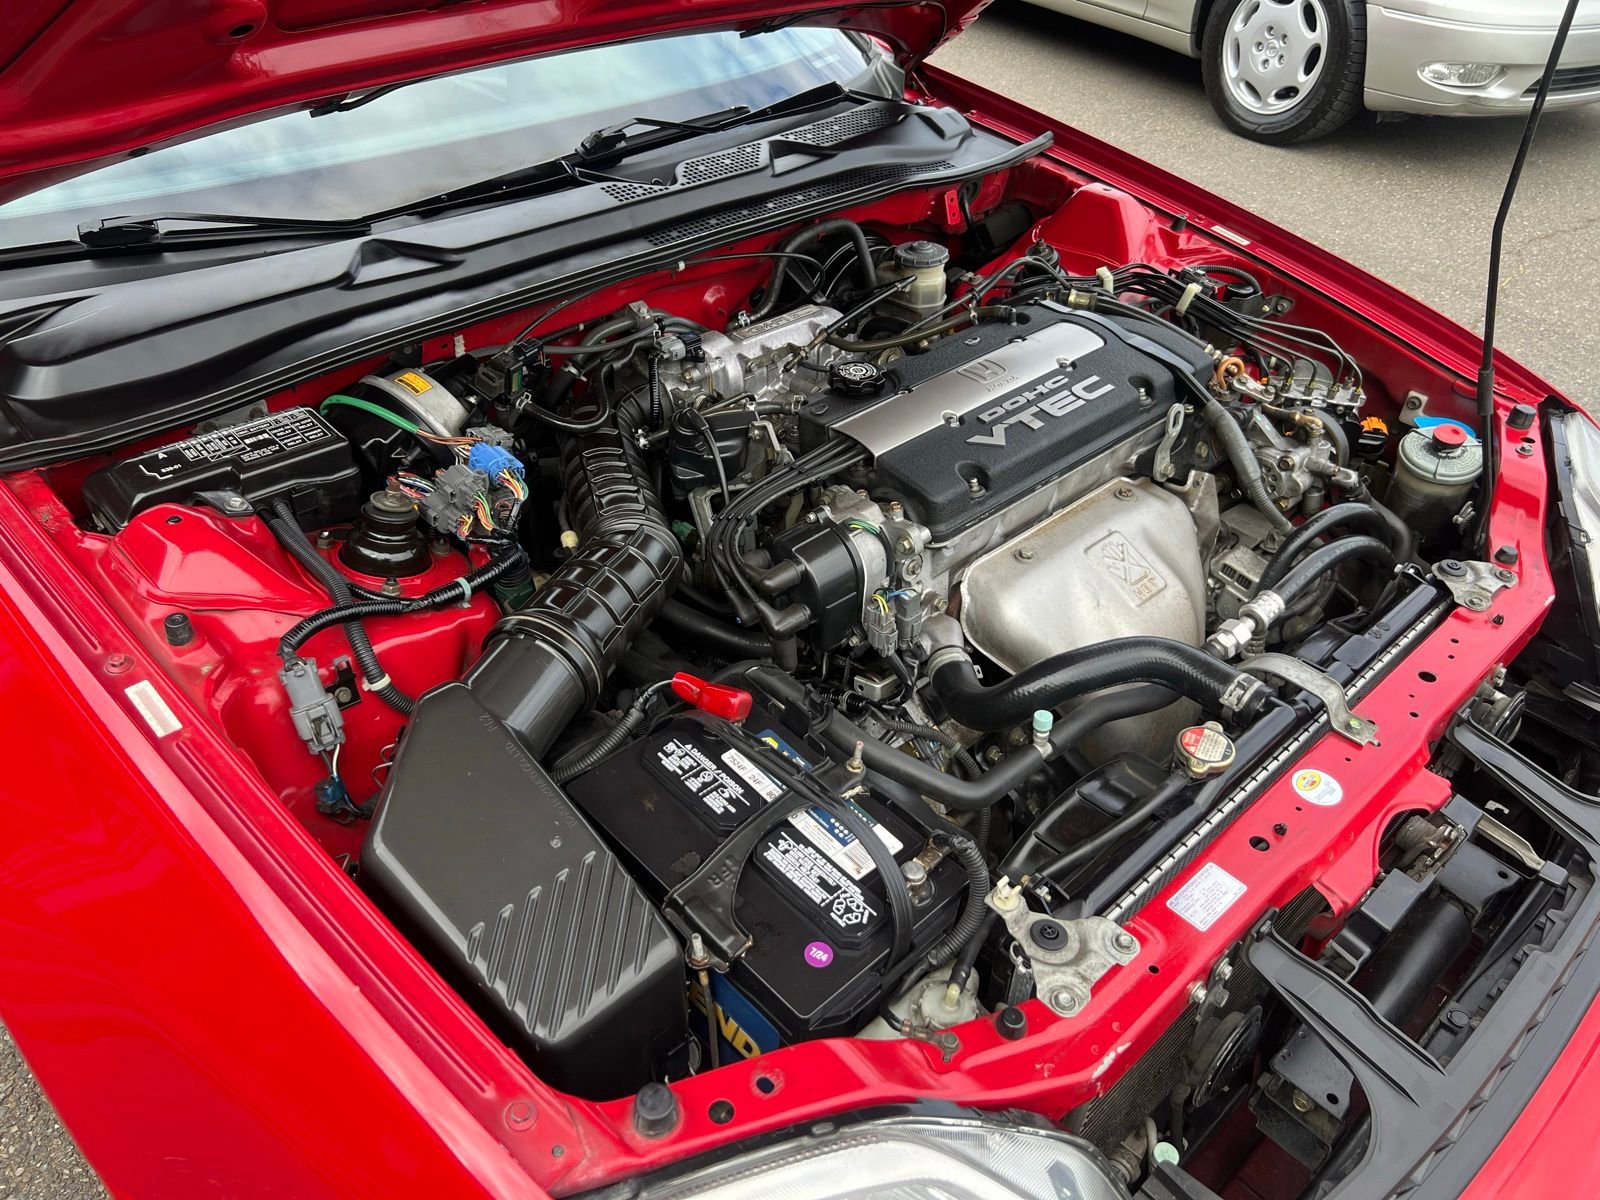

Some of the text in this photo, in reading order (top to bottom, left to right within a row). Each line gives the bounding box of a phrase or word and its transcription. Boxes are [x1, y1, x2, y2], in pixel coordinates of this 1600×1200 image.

[966, 374, 1116, 446] VTEC
[977, 375, 1070, 424] DOHC
[157, 451, 168, 460] A
[690, 746, 718, 773] DANGER
[718, 770, 746, 796] POISON
[726, 753, 748, 774] 7524F
[748, 773, 763, 787] 24F
[808, 946, 829, 963] 7/24
